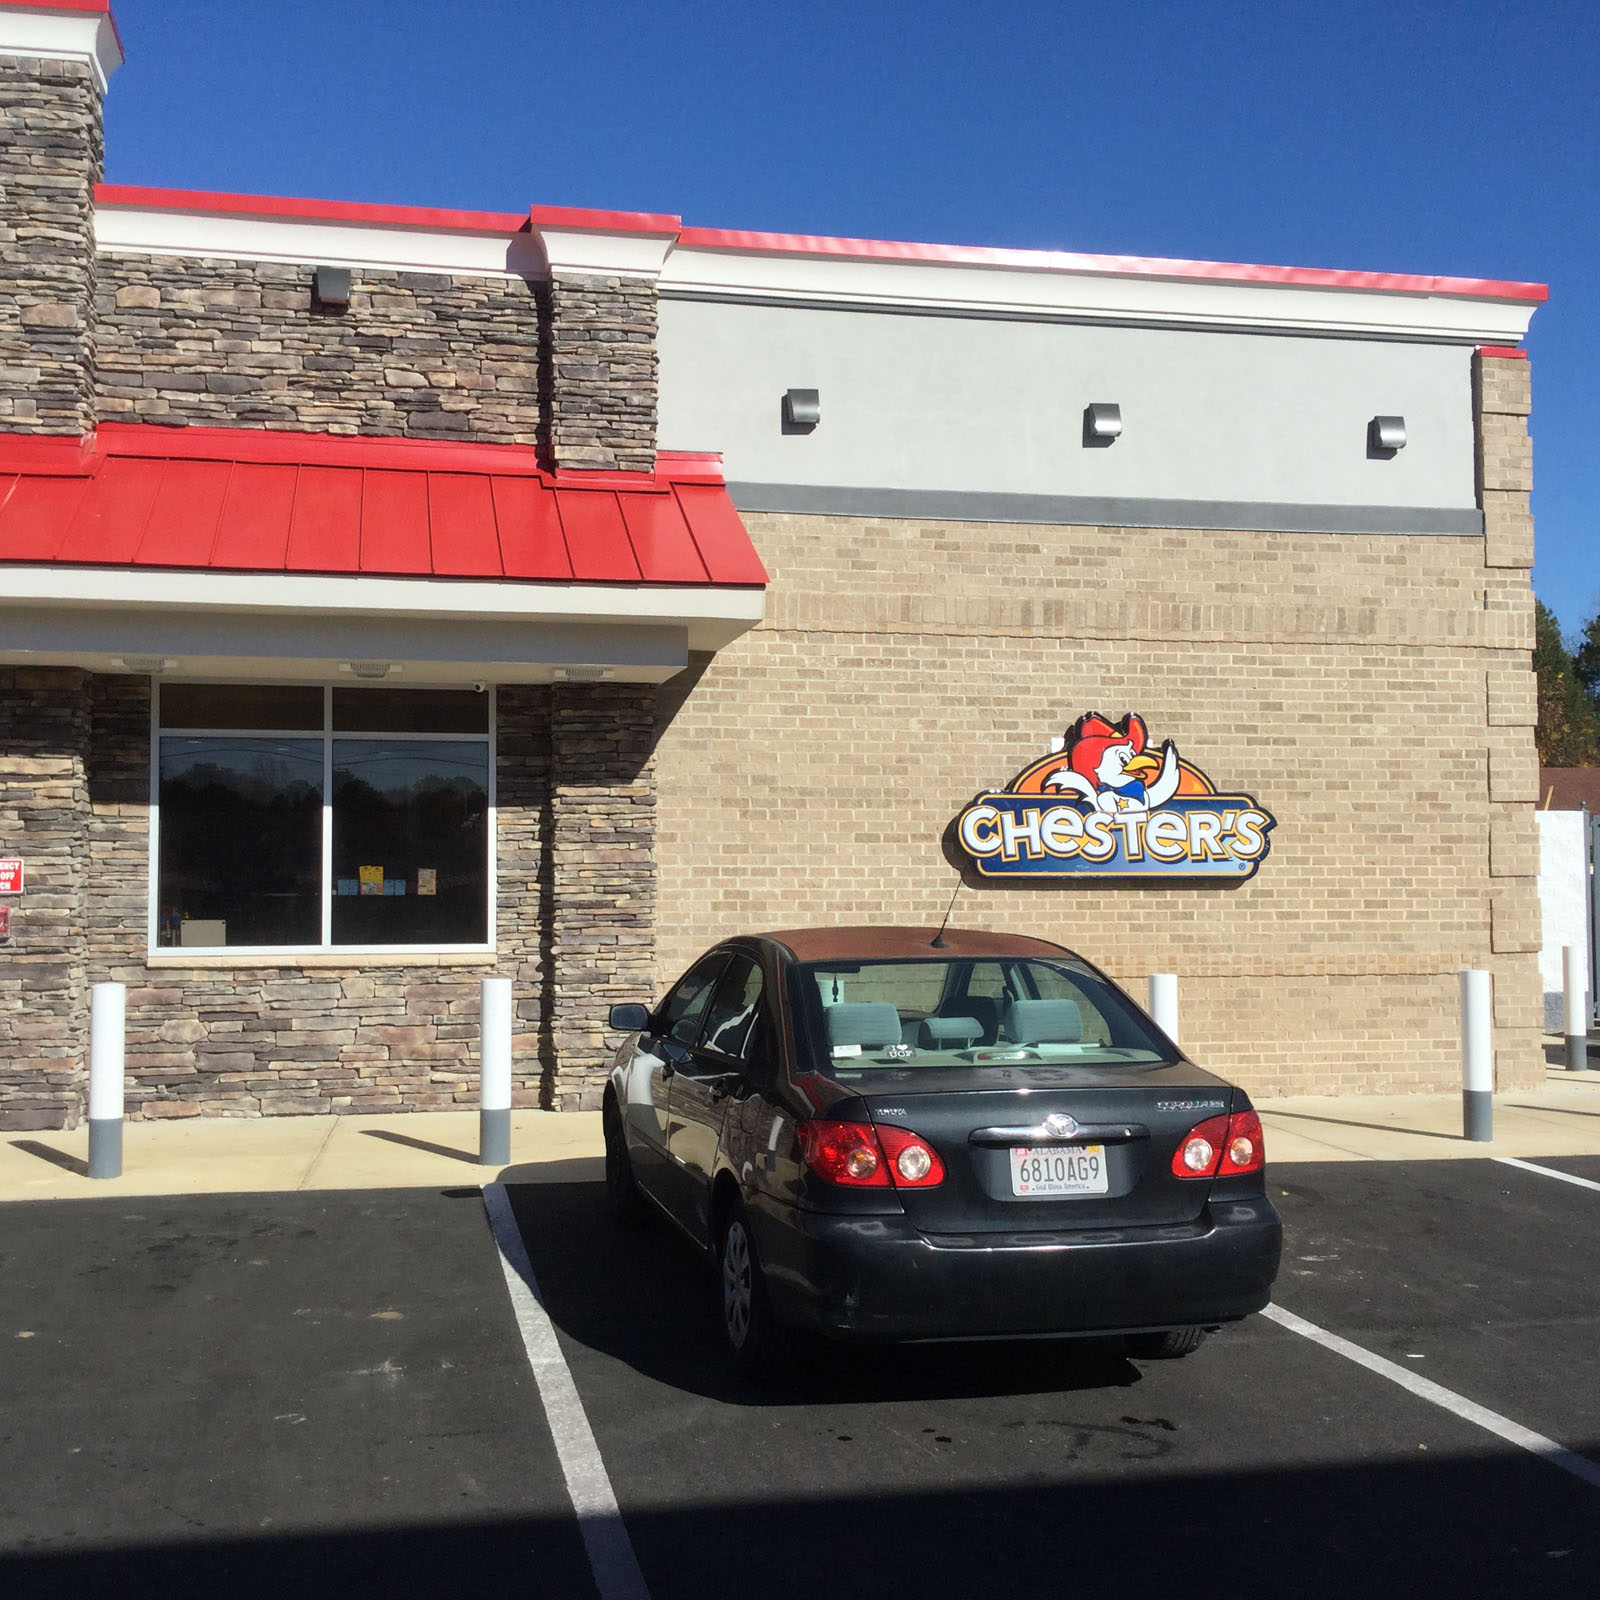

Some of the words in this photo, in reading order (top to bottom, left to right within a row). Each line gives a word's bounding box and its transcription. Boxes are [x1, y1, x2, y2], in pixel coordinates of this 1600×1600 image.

[875, 1108, 907, 1116] TOYOTA
[1033, 1146, 1083, 1155] ALABAMA
[1020, 1156, 1099, 1182] 6810AG9
